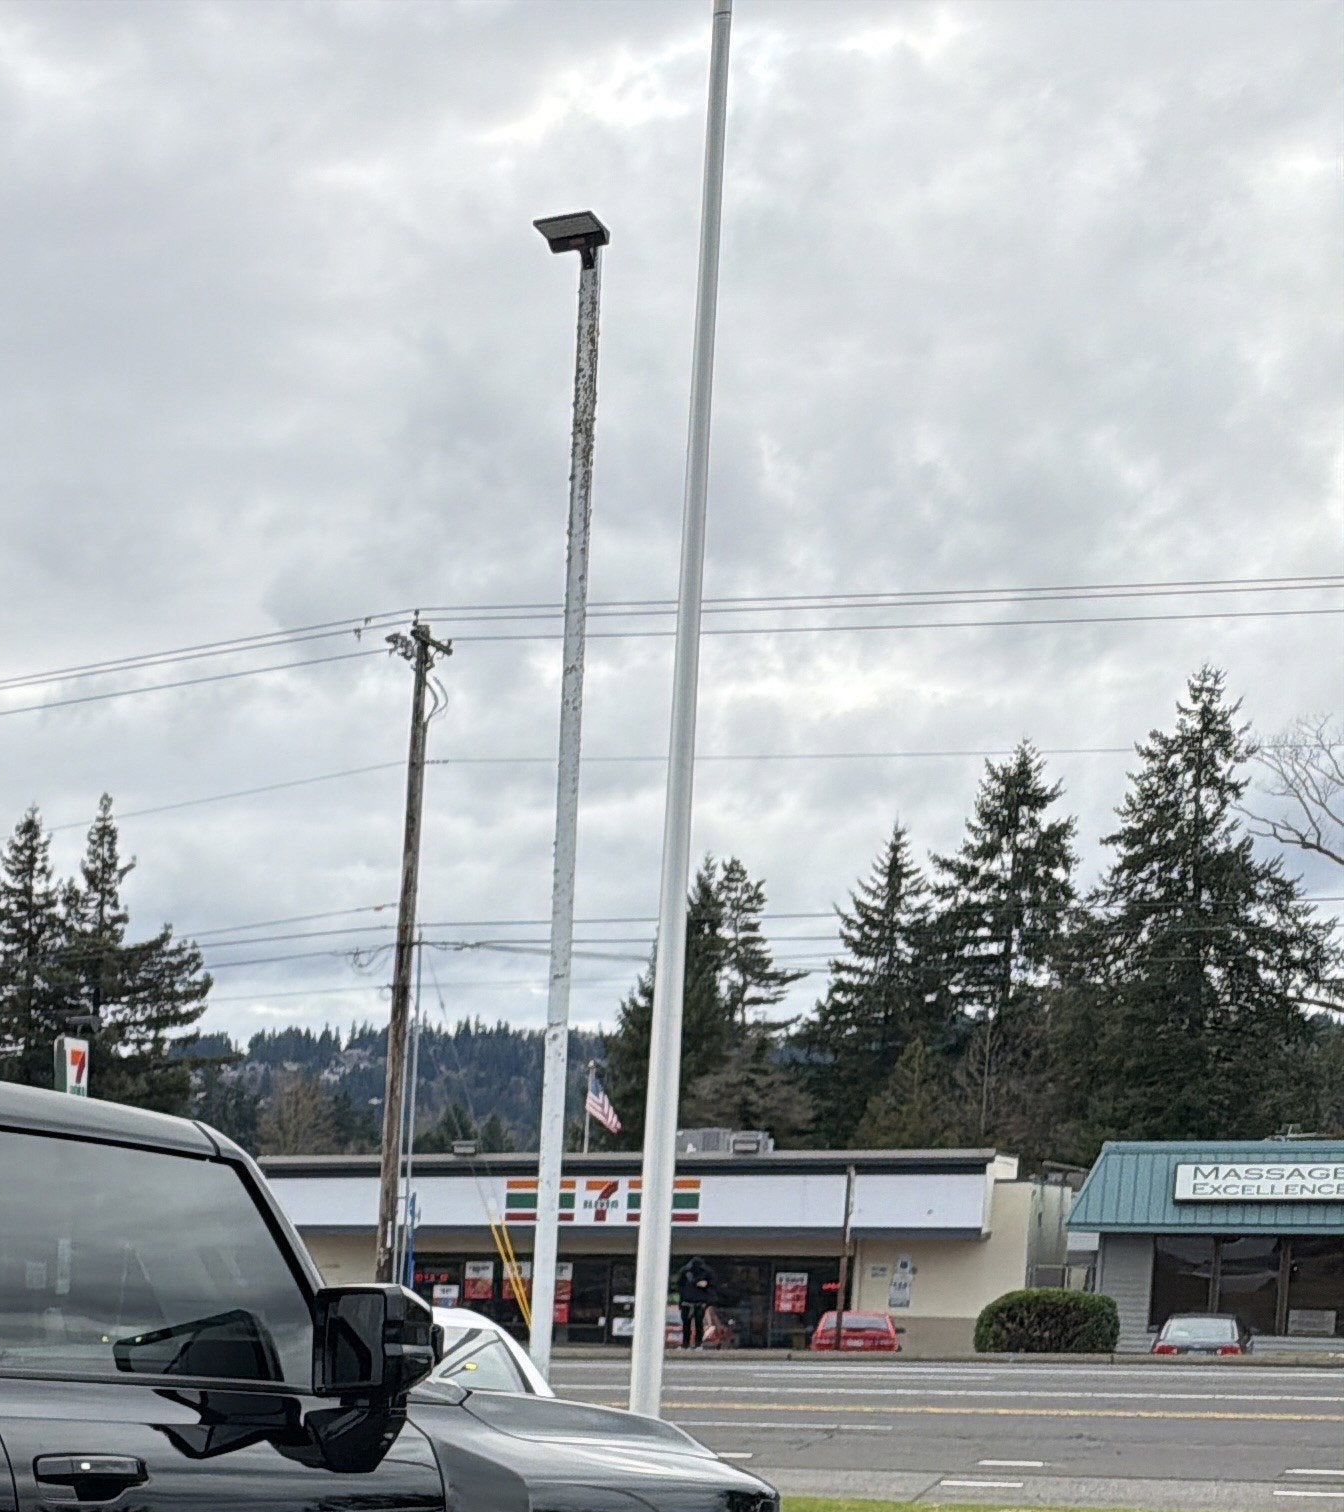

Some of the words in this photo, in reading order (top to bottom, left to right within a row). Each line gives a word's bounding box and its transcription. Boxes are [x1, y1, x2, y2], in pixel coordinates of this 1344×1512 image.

[71, 1049, 86, 1084] 7
[1193, 1166, 1344, 1181] MASSAGE
[585, 1180, 619, 1222] 7
[1192, 1183, 1344, 1196] EXCELLENCE
